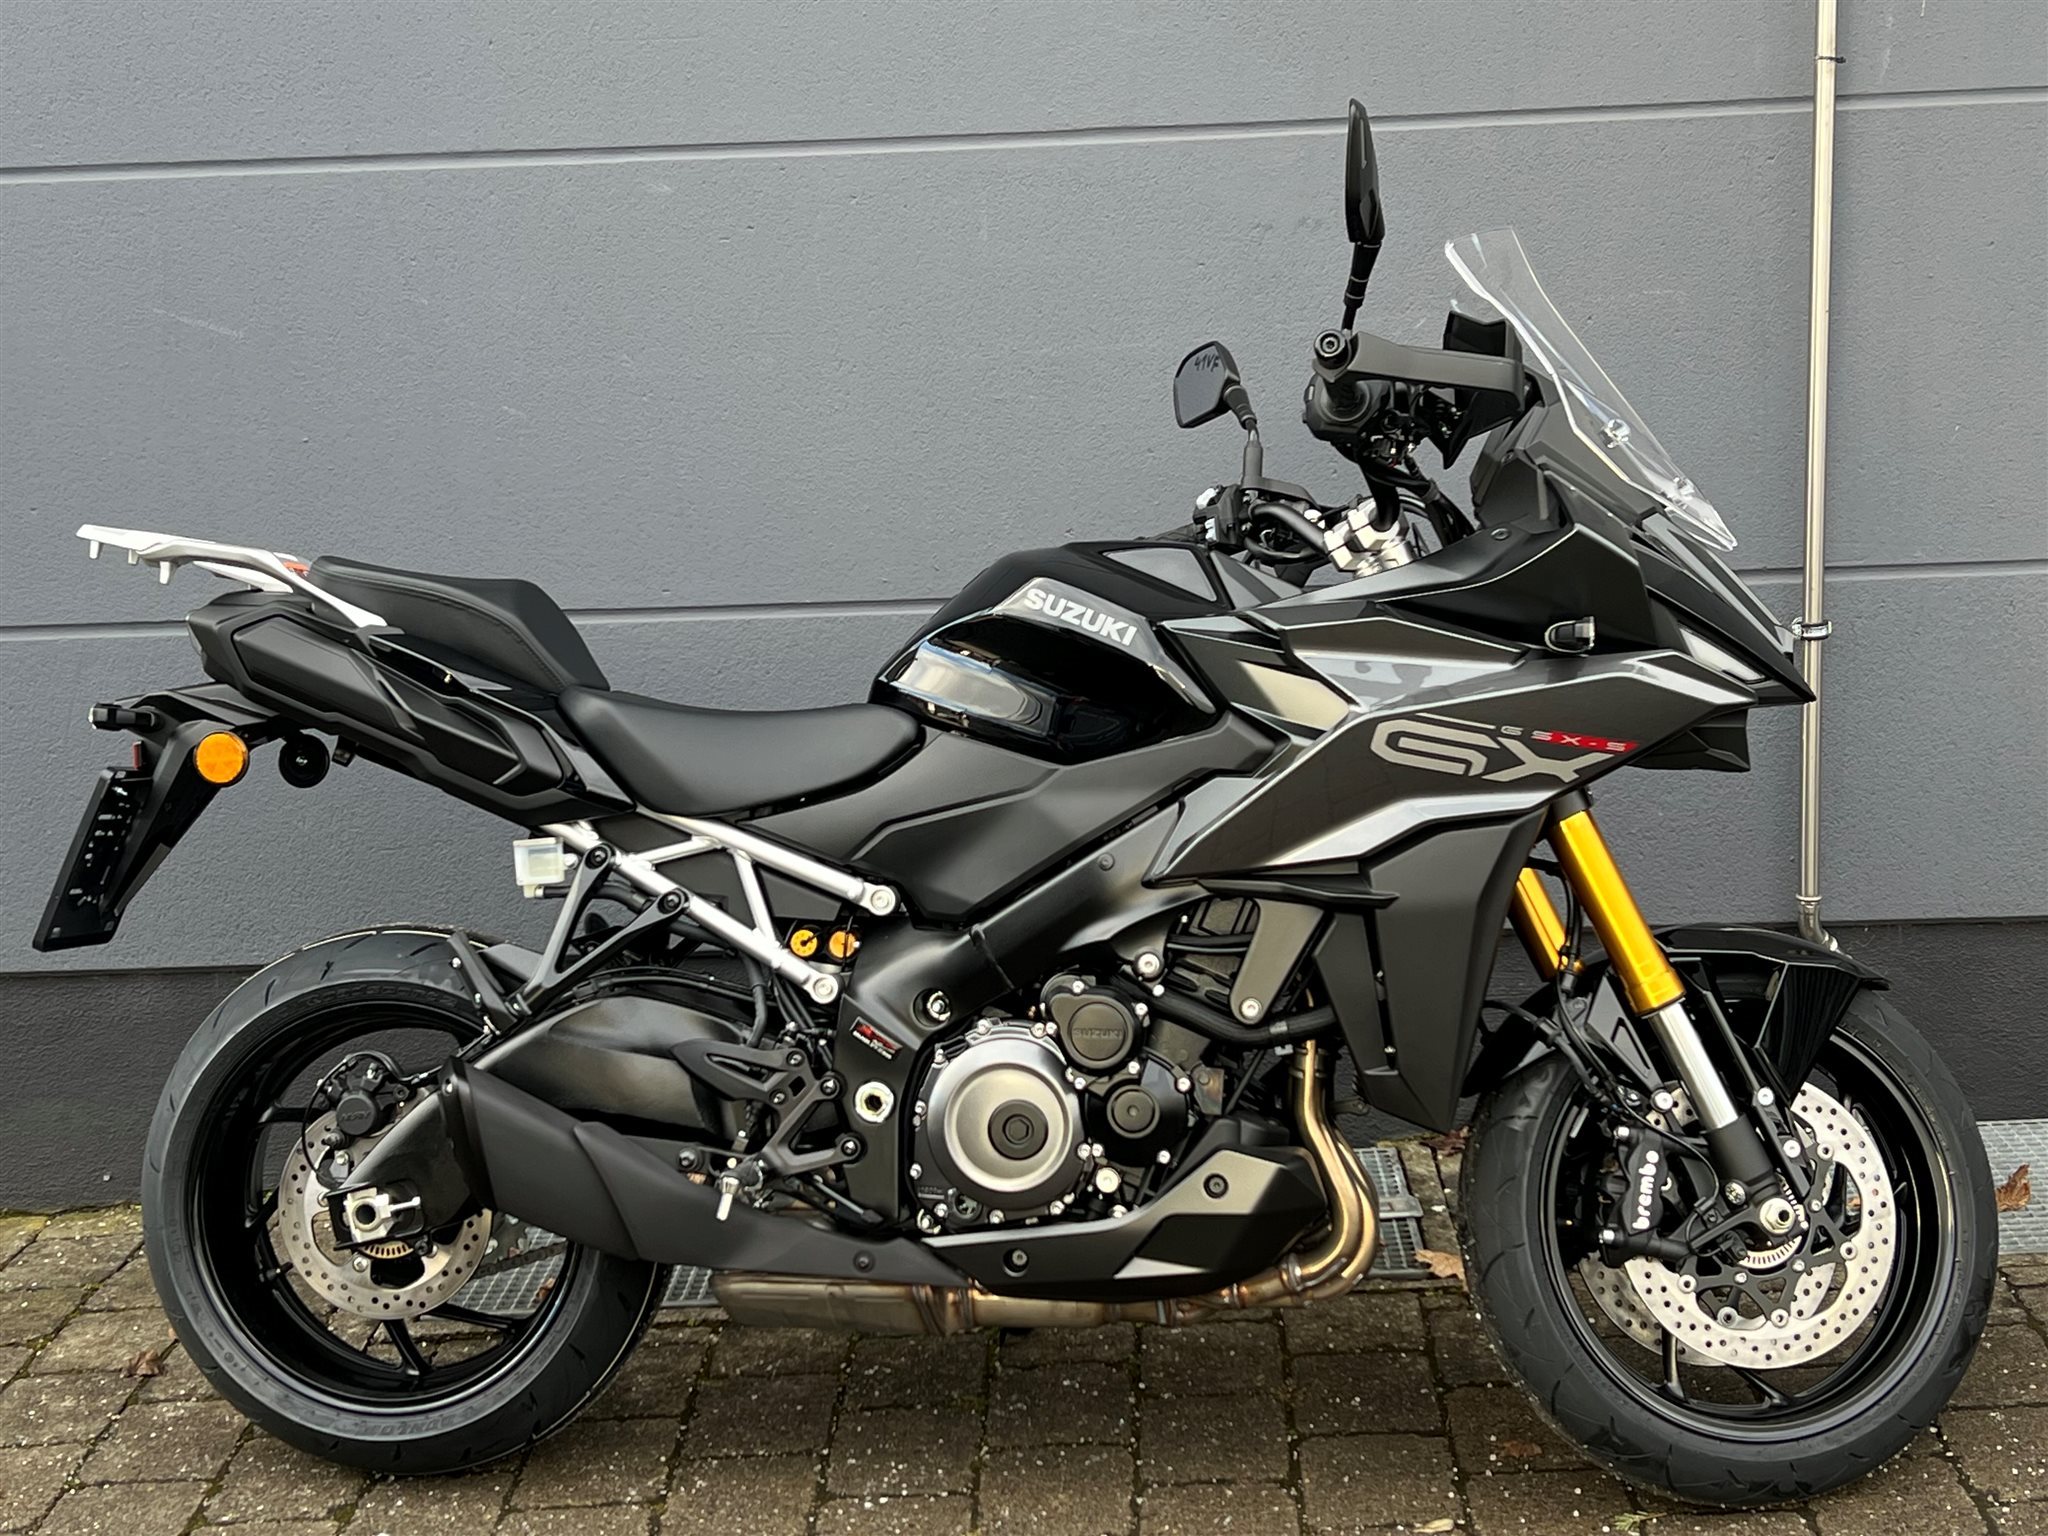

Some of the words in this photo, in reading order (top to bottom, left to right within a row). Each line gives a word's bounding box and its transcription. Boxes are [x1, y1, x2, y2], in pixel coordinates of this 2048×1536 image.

[1024, 588, 1137, 646] SUZUKI
[1370, 713, 1614, 783] GX
[1073, 1027, 1123, 1040] SUZUKI
[1632, 1150, 1659, 1229] brembo
